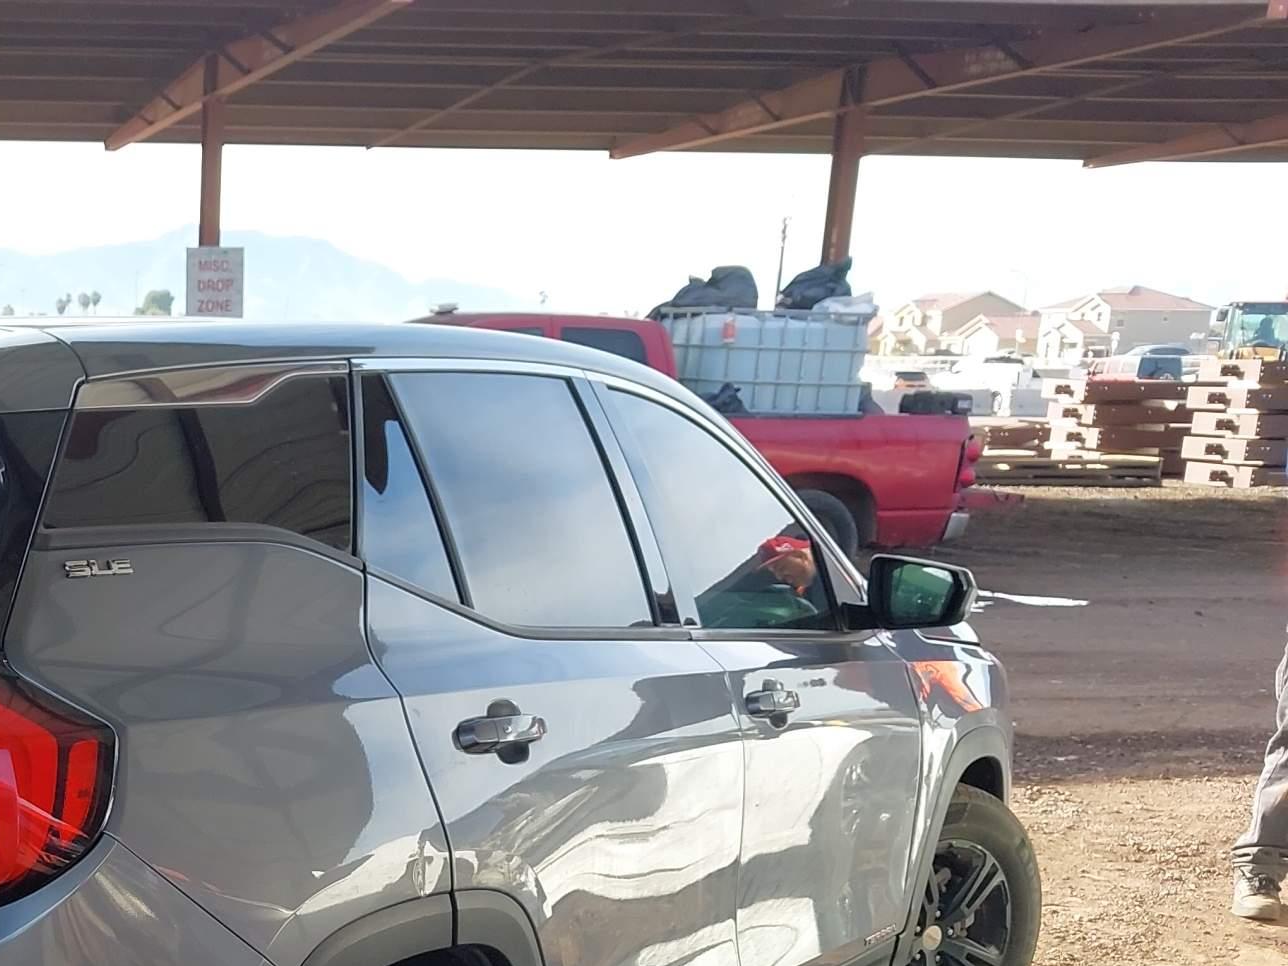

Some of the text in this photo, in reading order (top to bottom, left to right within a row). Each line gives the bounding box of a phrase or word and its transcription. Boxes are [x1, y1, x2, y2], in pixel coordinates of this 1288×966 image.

[197, 279, 234, 292] DROP
[197, 299, 233, 313] ZONE
[64, 559, 134, 578] SLE
